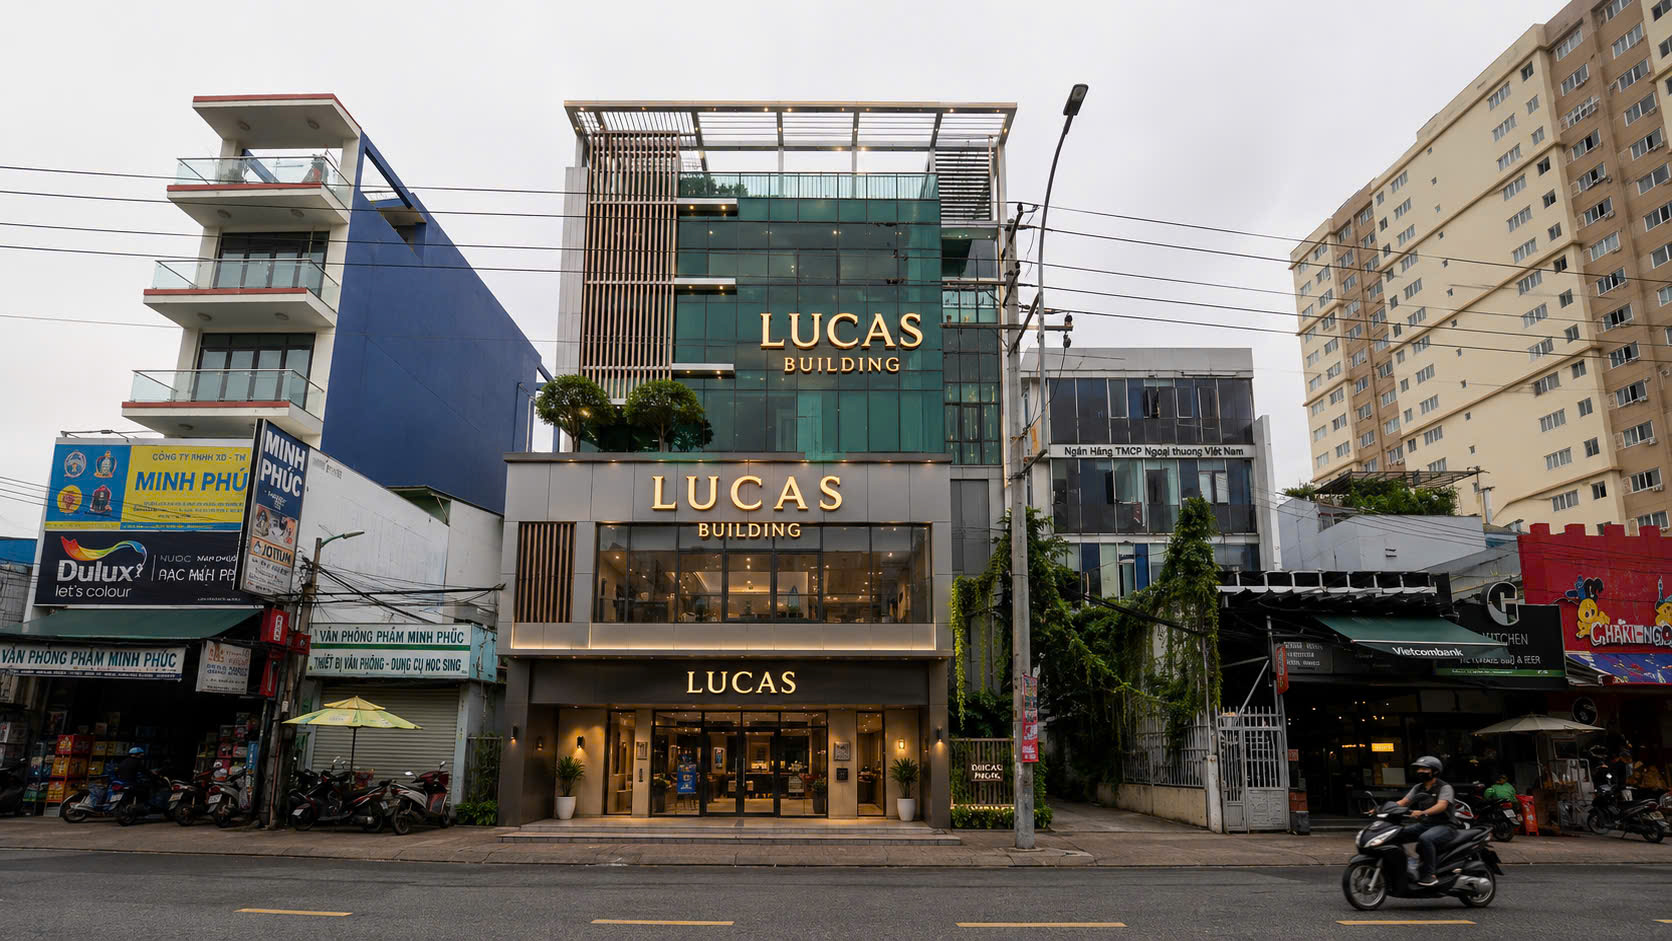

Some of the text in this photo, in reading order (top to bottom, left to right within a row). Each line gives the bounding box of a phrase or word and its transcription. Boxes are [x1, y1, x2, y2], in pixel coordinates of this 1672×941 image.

[760, 312, 924, 350] LUCAS
[784, 357, 900, 373] BUILDING
[264, 430, 305, 472] MINH
[1115, 447, 1142, 455] TMCP
[1224, 447, 1243, 456] Nam
[135, 472, 195, 491] MINH
[260, 458, 302, 497] PHÚC
[651, 475, 843, 511] LUCAS
[698, 522, 801, 538] BUILDING
[57, 559, 134, 582] Dulux
[55, 585, 132, 598] let's colour
[108, 651, 140, 667] MINH
[1392, 646, 1464, 656] Vietcombank
[686, 671, 796, 694] LUCAS
